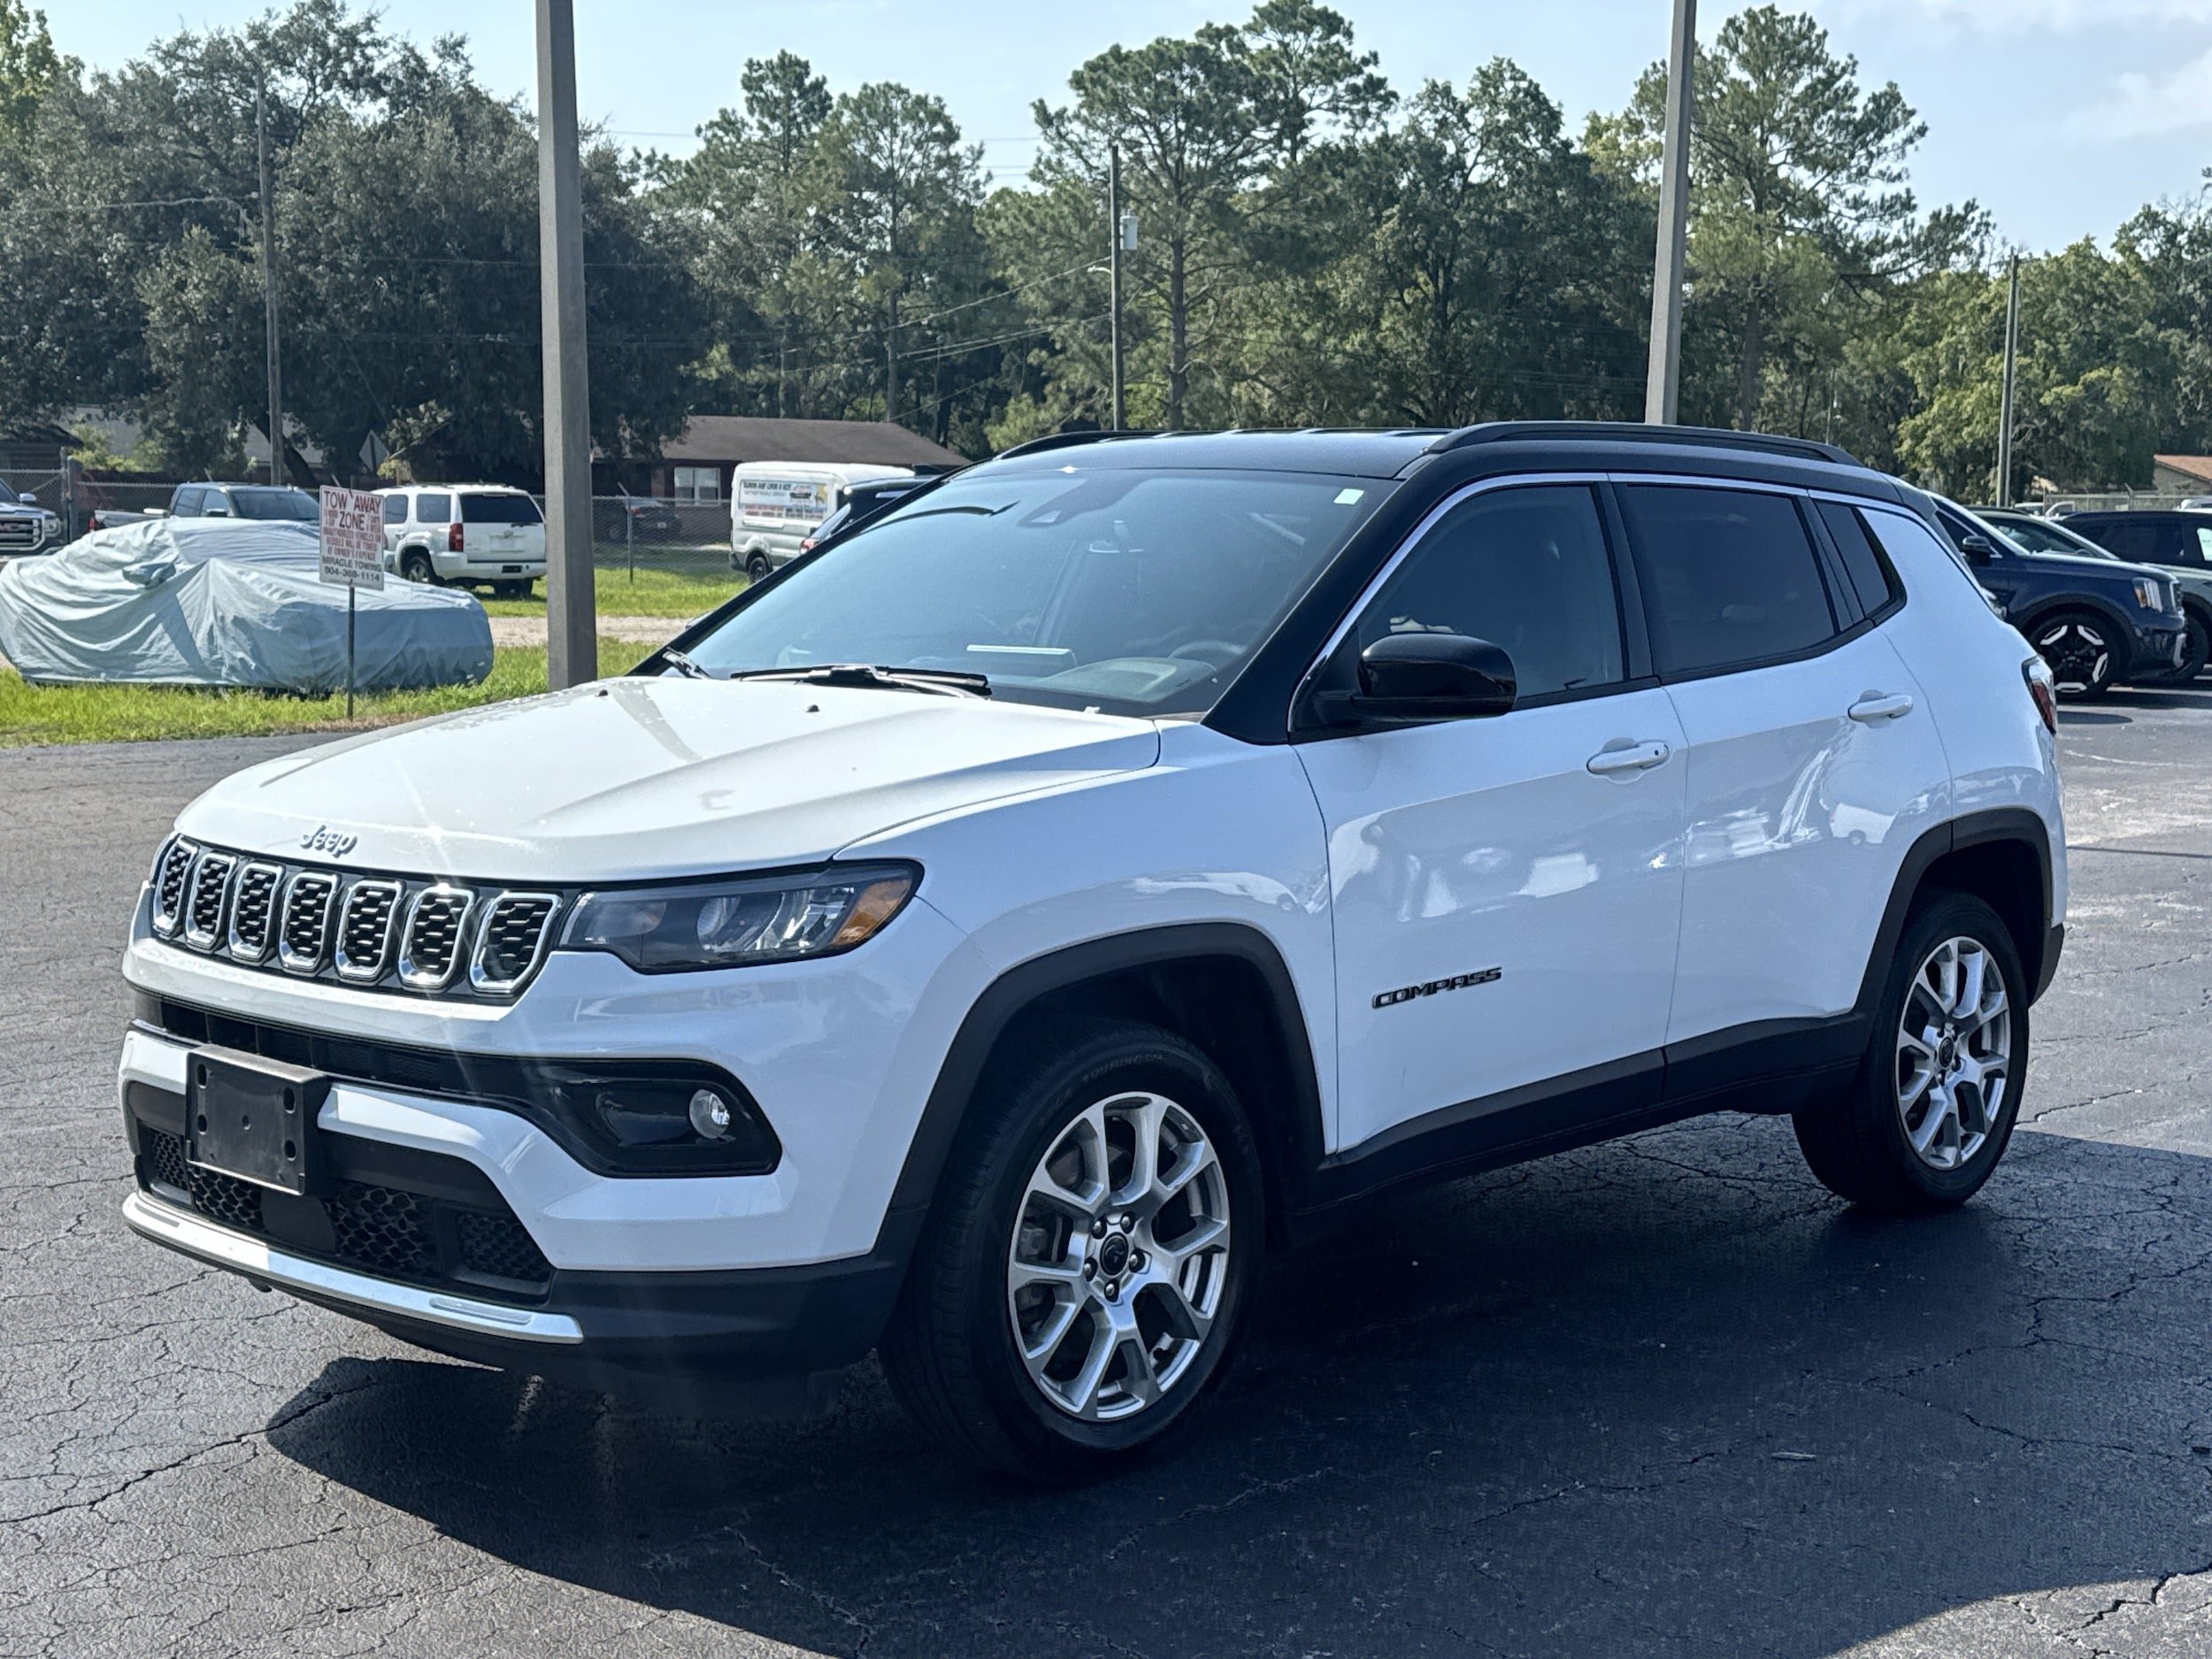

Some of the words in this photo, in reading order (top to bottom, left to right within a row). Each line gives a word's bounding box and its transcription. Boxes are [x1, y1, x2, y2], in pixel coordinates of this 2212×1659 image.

[325, 490, 347, 510] TOW
[354, 495, 380, 515] AWAY
[340, 511, 365, 531] ZONE
[323, 556, 352, 567] MIRACLE
[356, 561, 381, 572] TOWING
[300, 825, 357, 858] Jeep
[1372, 966, 1502, 1009] COMPASS
